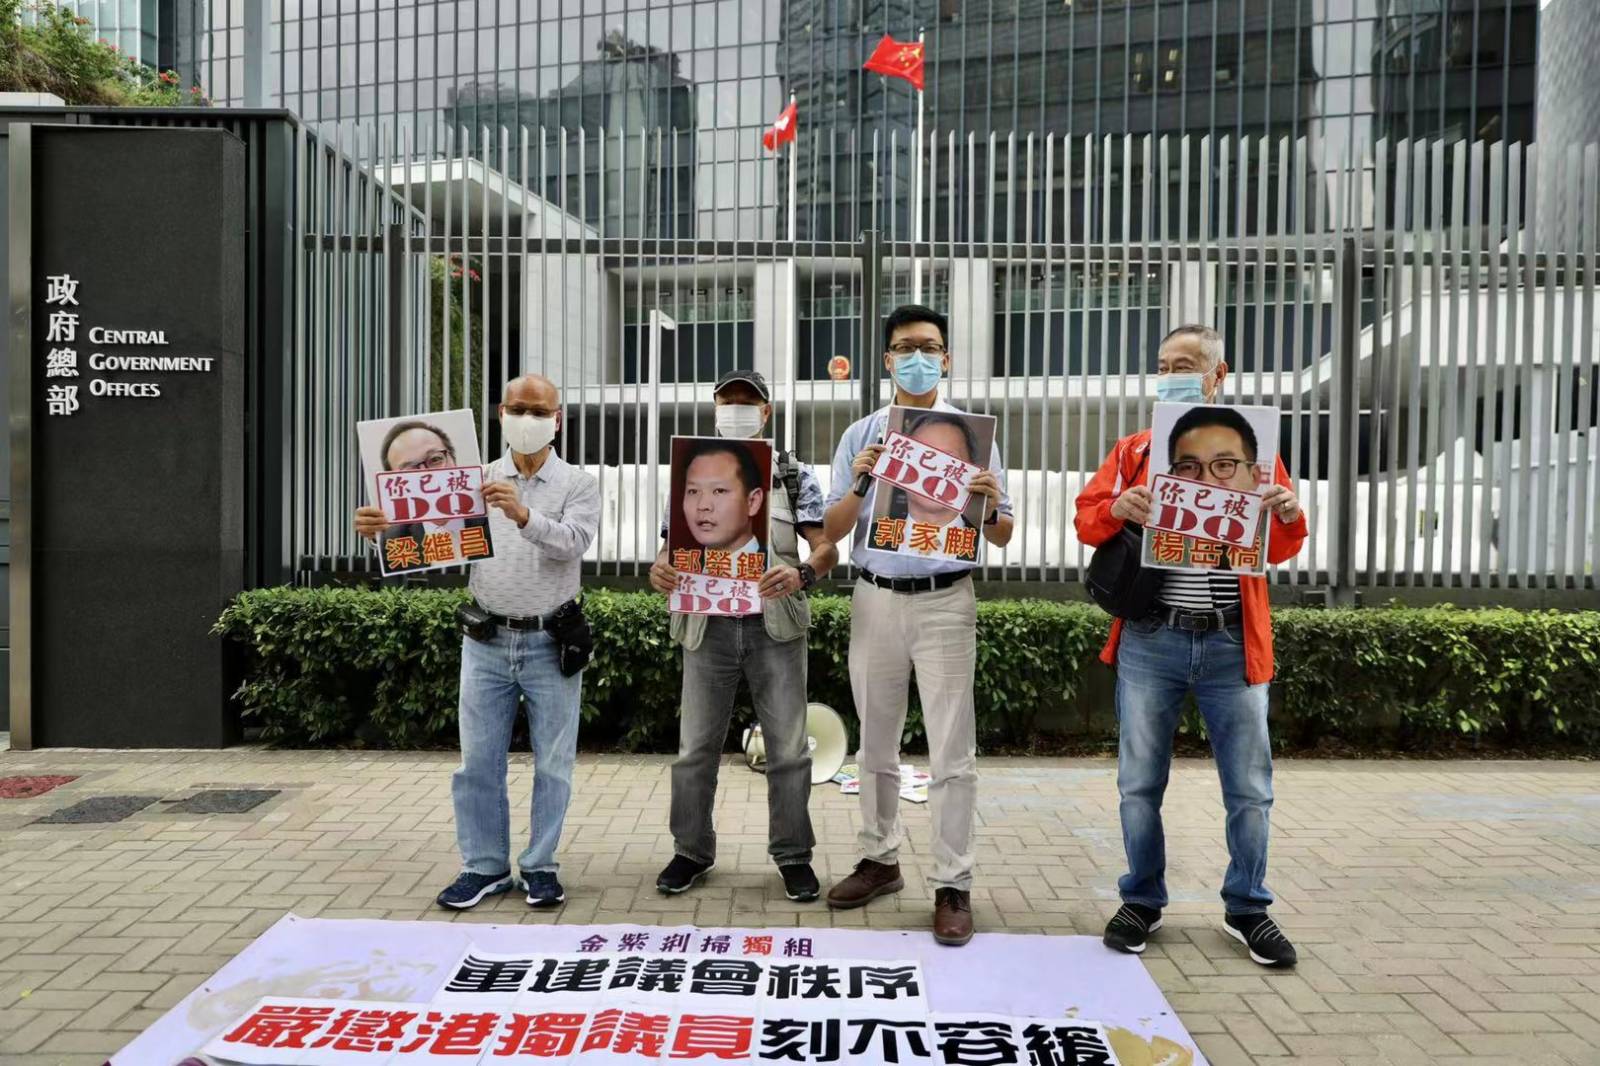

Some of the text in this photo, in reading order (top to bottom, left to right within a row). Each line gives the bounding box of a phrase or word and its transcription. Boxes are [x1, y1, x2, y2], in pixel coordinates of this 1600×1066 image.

[46, 273, 79, 416] 政府總部
[880, 456, 959, 505] DQ
[390, 492, 475, 522] DQ
[1155, 503, 1245, 544] DQ
[385, 527, 489, 570] 梁繼昌
[445, 954, 920, 1000] 重建議會秩序
[223, 1005, 1115, 1066] 嚴懲港獨議員刻不容緩
